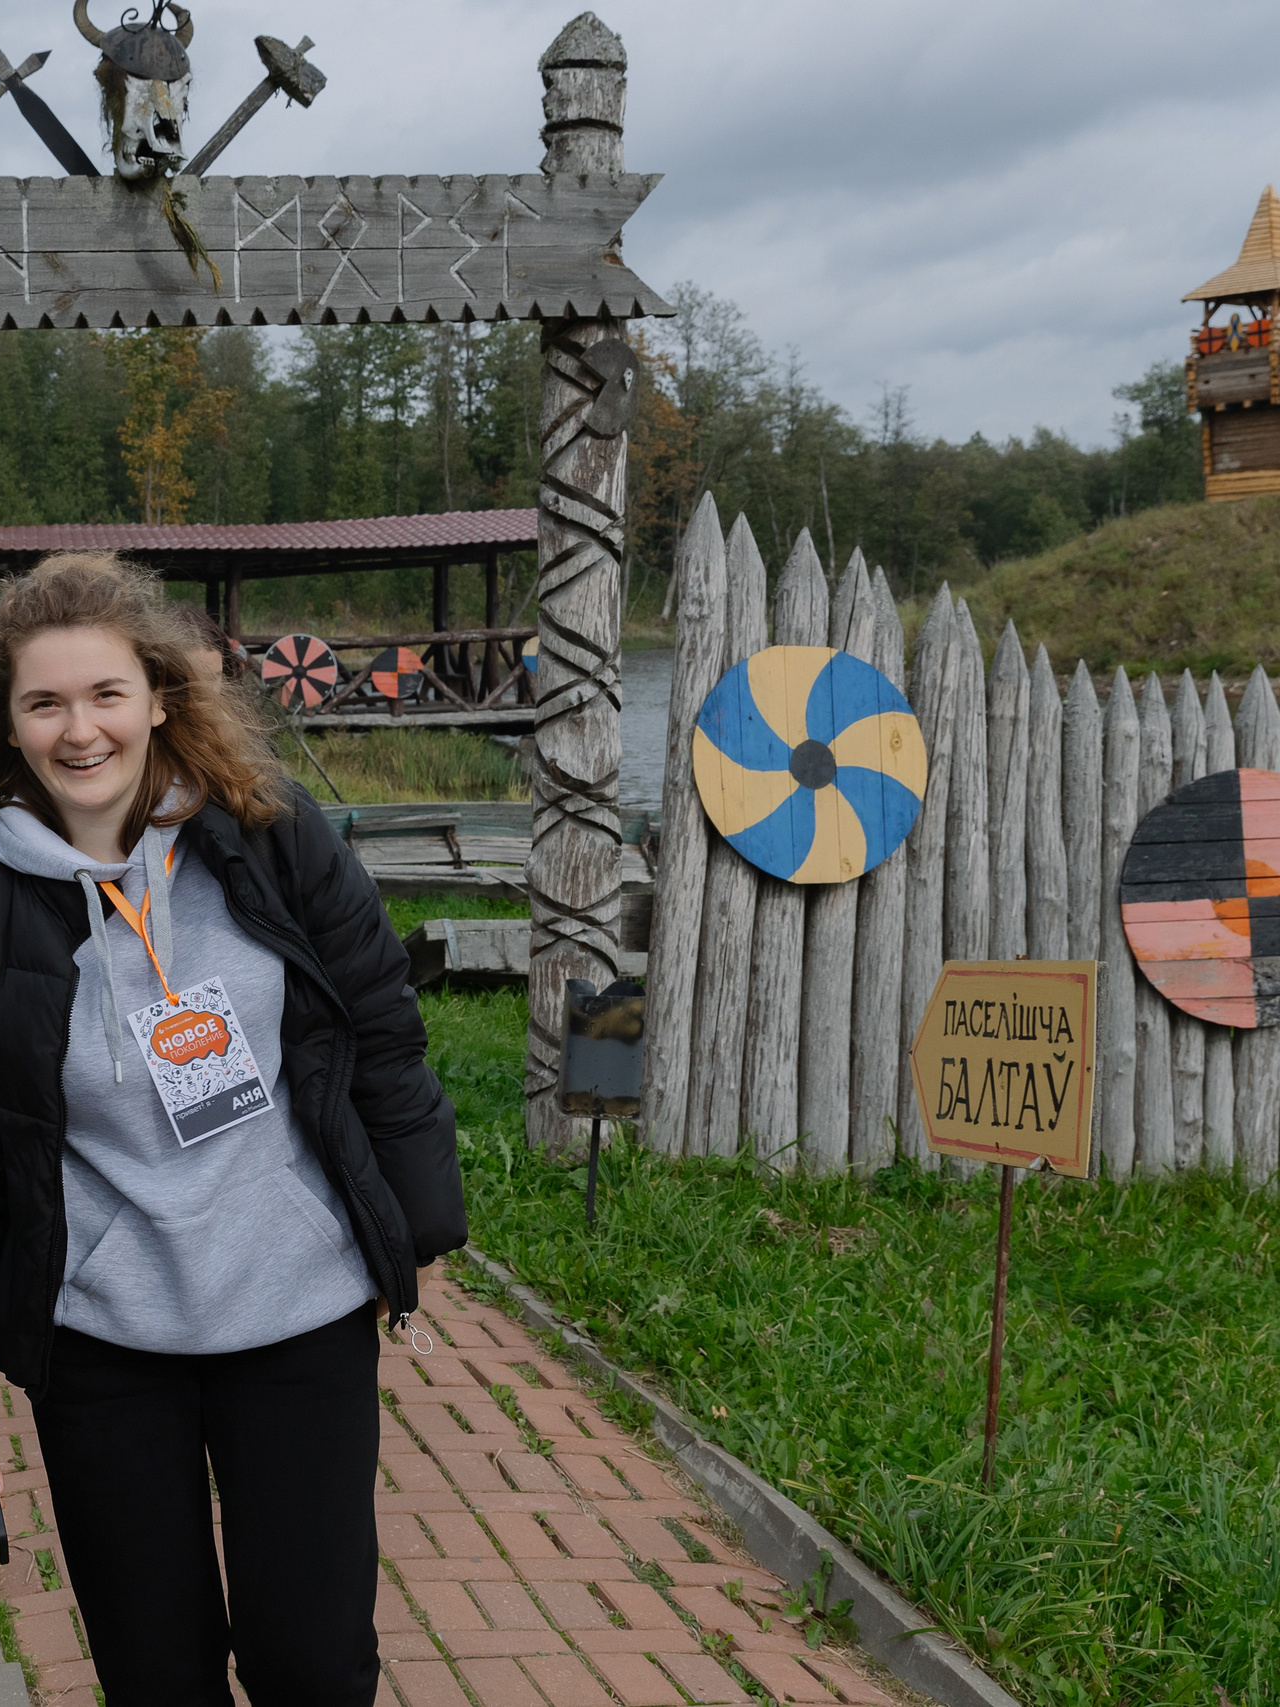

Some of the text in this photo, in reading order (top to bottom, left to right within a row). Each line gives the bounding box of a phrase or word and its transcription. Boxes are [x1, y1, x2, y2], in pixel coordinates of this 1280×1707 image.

[159, 1018, 218, 1053] НОВОЕ
[170, 1030, 225, 1059] ПОКОЛЕНИЕ
[232, 1086, 264, 1111] АНЯ
[936, 1050, 1074, 1132] БАЛТАЎ
